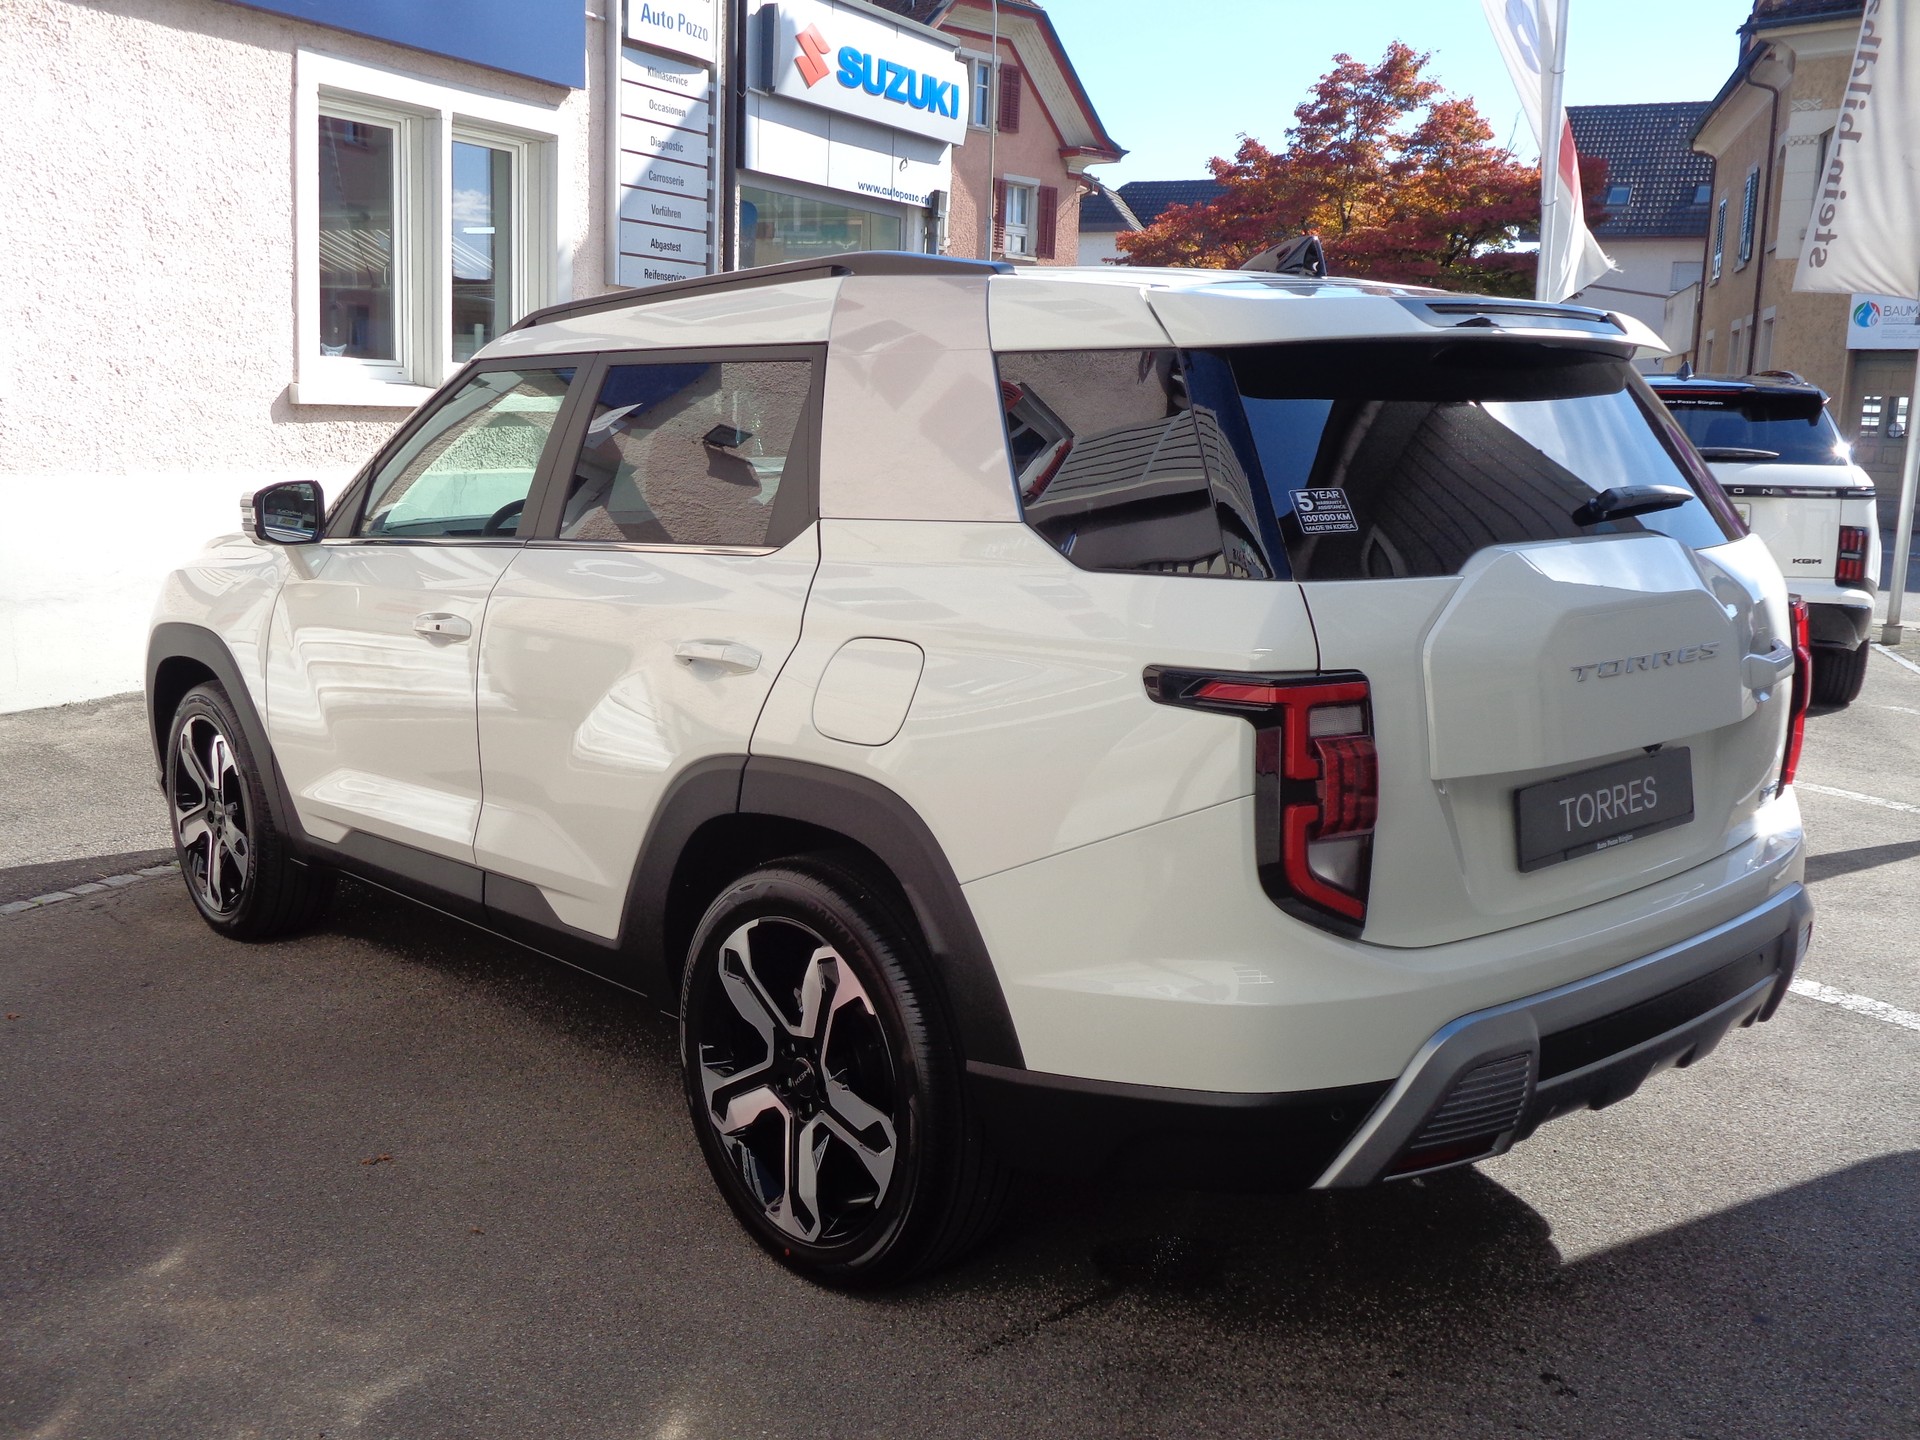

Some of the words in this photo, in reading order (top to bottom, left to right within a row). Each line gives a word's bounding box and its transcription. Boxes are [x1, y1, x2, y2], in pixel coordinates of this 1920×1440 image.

[641, 3, 674, 29] Auto
[678, 13, 708, 41] Pozzo
[647, 66, 688, 87] Klimaservice
[836, 46, 960, 120] SUZUKI
[649, 99, 686, 117] Occasionen
[650, 136, 684, 152] Diagnostic
[648, 170, 685, 187] Carrosserie
[651, 204, 682, 219] Vorführen
[650, 238, 682, 252] Abgastest
[1295, 492, 1314, 512] 5
[1311, 491, 1340, 499] YEAR
[1570, 641, 1720, 683] TORRES
[1559, 776, 1658, 832] TORRES
